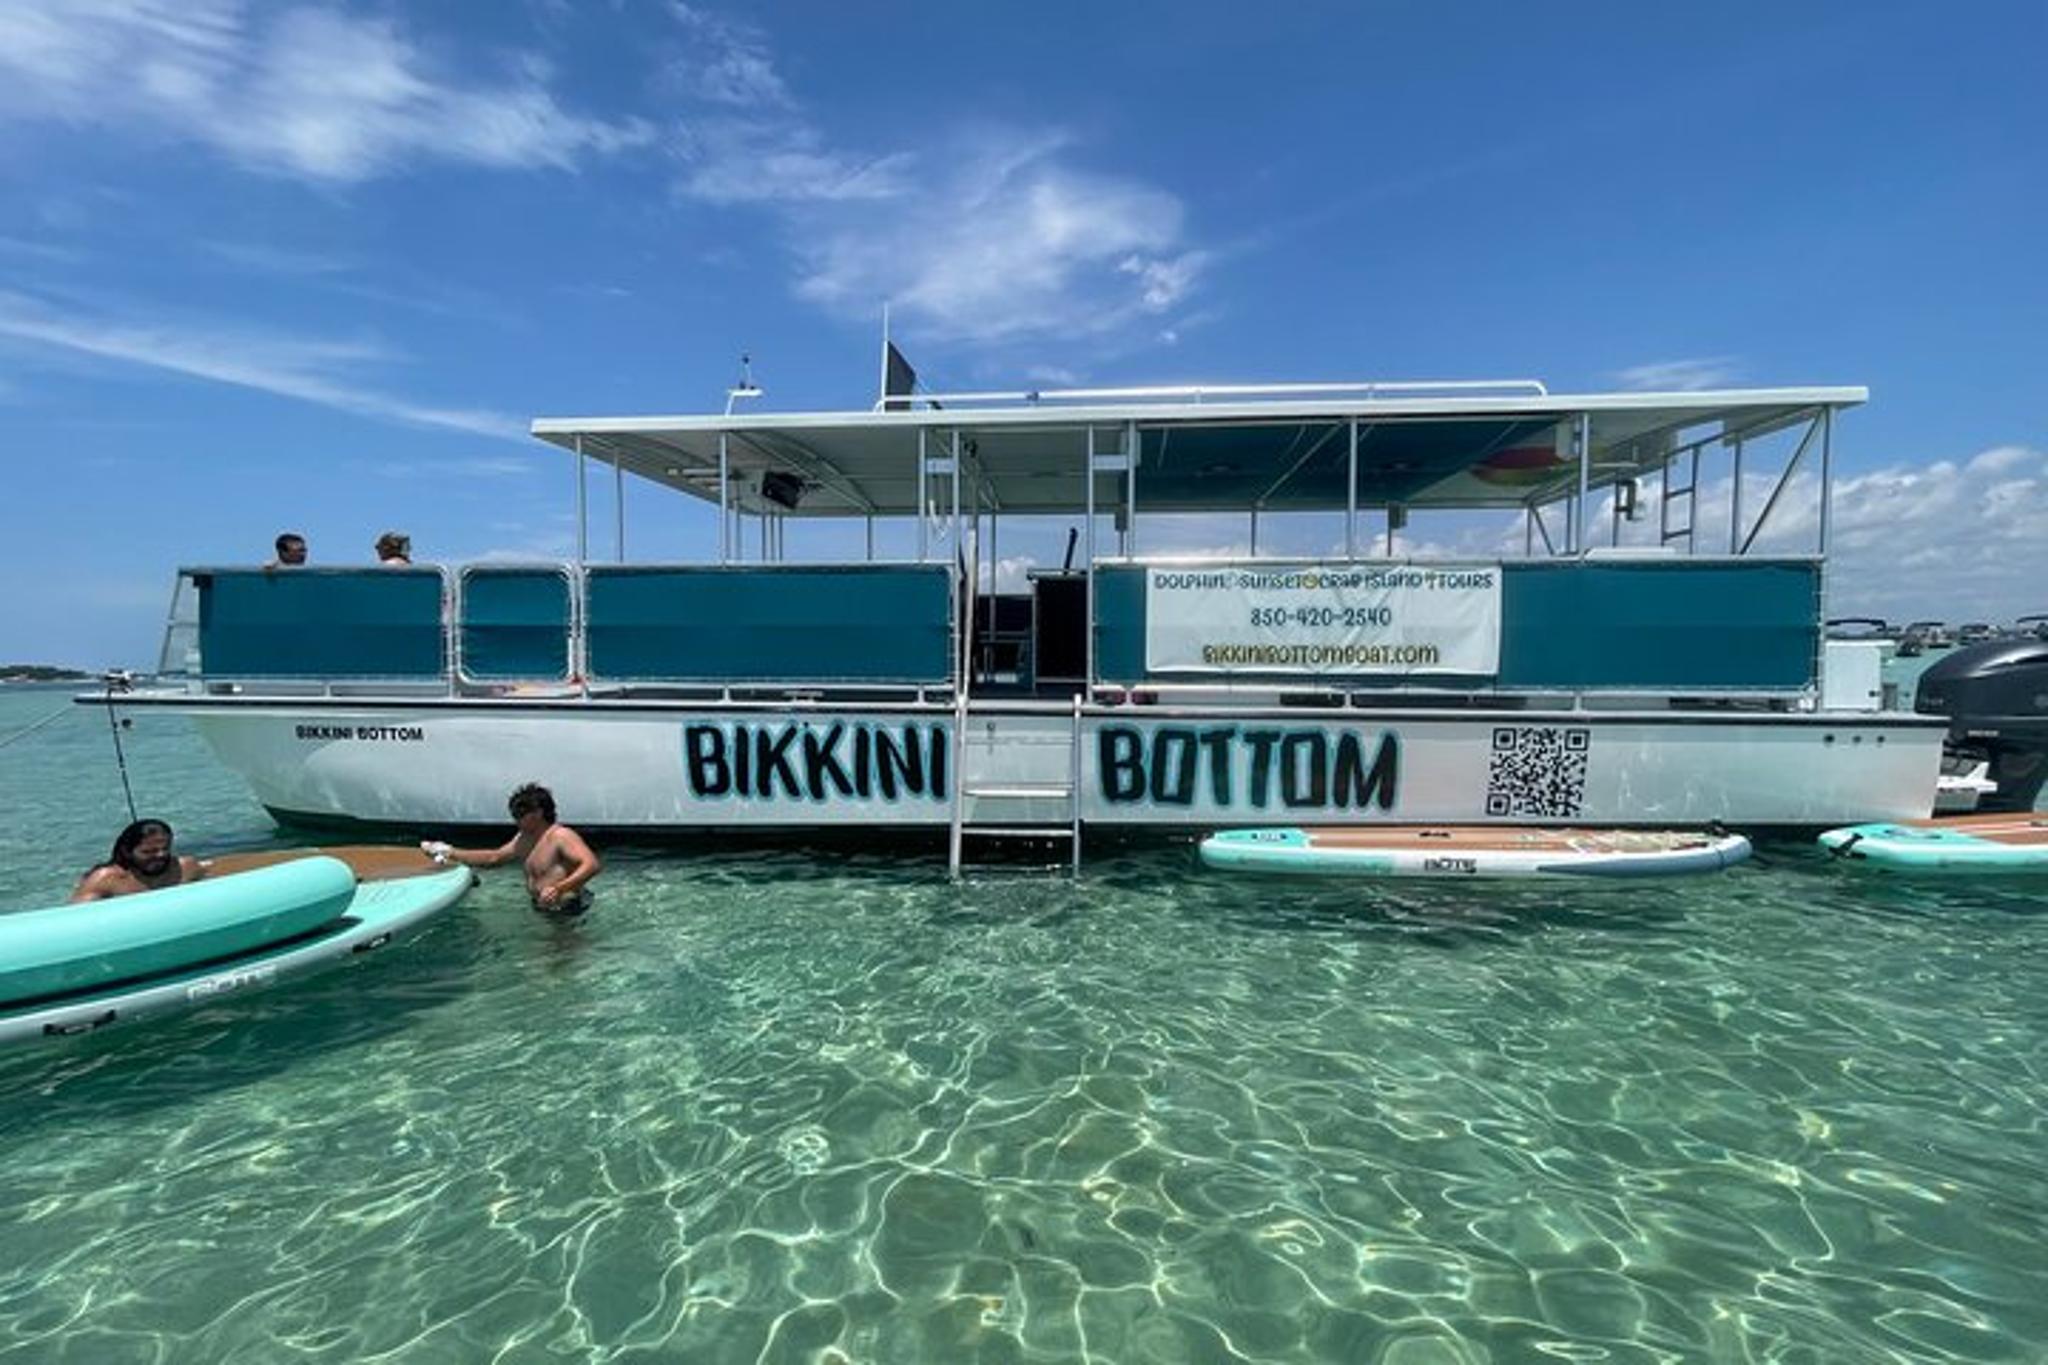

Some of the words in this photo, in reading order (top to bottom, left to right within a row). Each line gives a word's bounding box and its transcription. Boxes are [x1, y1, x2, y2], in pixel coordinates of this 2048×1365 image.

[1250, 608, 1392, 626] 850-420-2540
[295, 725, 354, 740] BIKKINI
[357, 726, 425, 741] BOTTOM
[684, 721, 950, 802] BIKKINI
[1097, 724, 1398, 809] BOTTOM
